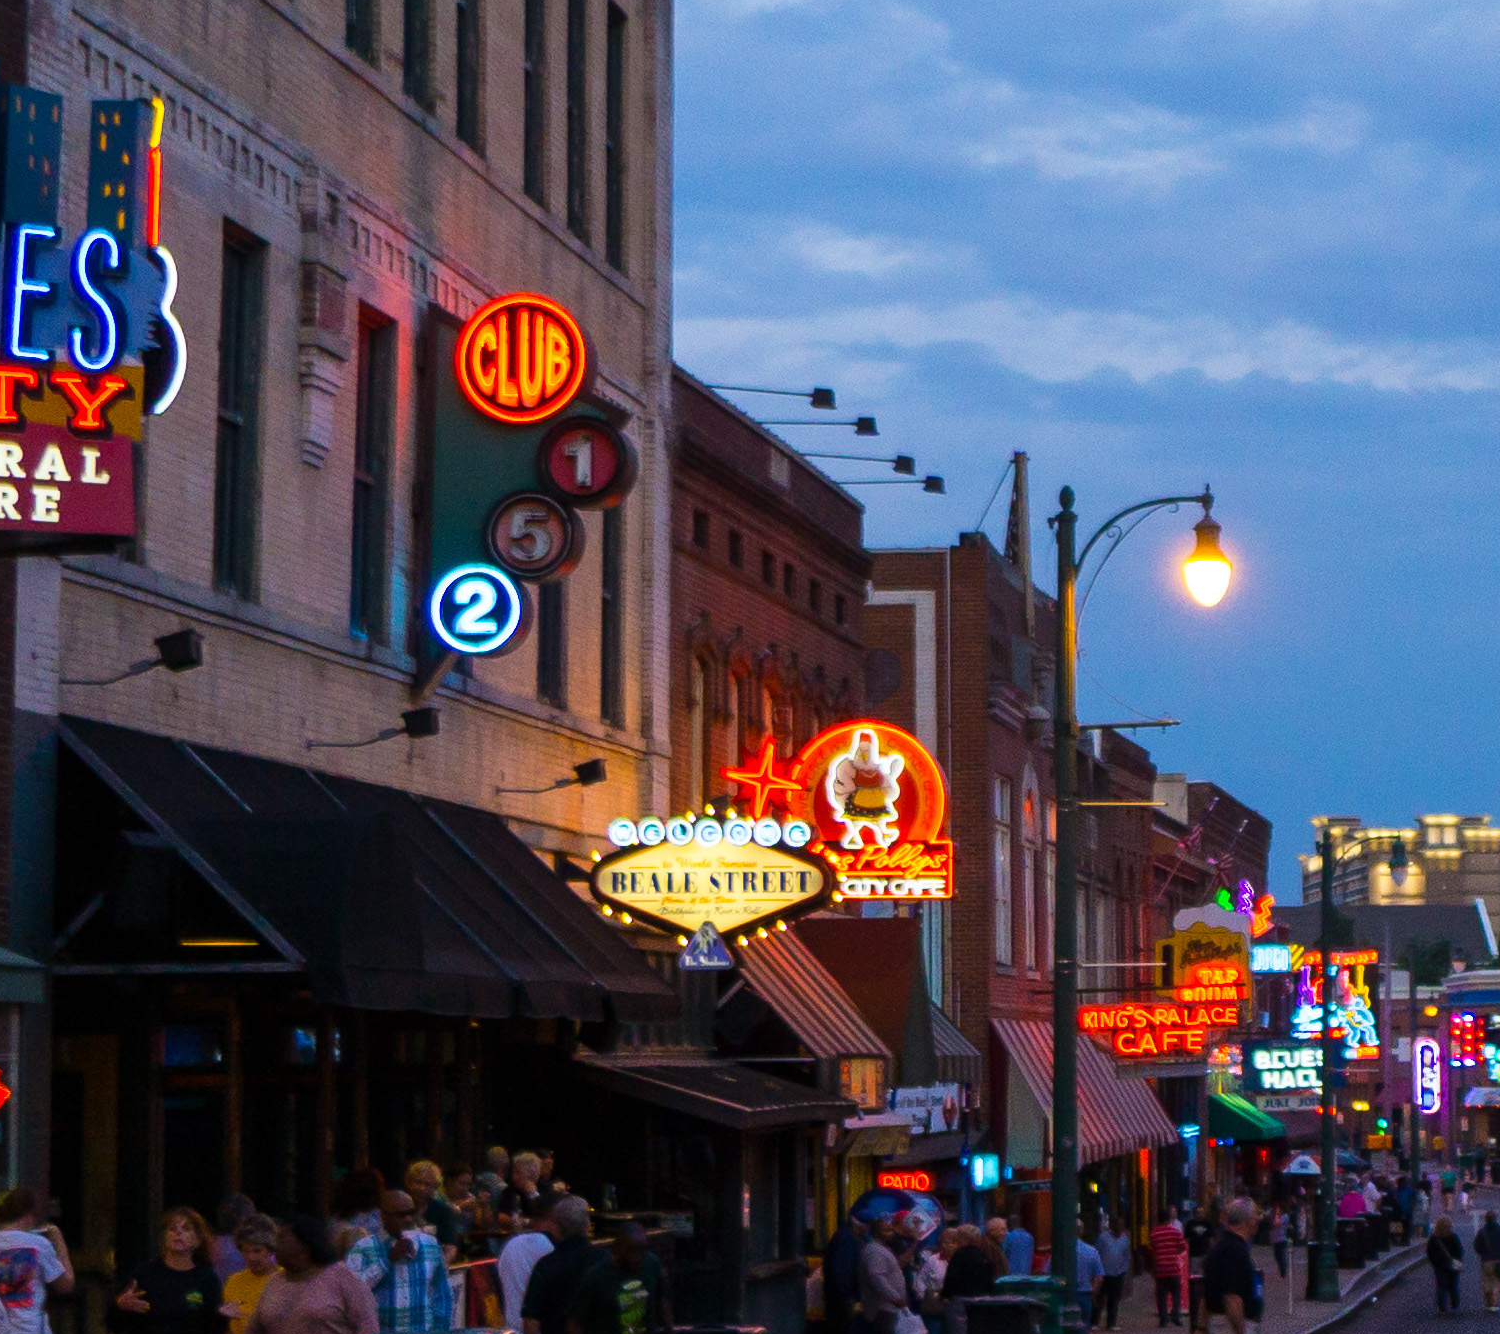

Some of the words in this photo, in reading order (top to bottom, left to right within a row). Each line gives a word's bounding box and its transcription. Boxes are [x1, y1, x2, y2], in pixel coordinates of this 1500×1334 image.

[471, 312, 571, 405] CLUB
[568, 433, 592, 488] 1
[509, 507, 553, 561] 5
[453, 581, 499, 637] 2
[676, 857, 711, 869] World
[717, 856, 758, 869] Famous
[611, 872, 698, 894] BEALE
[709, 871, 812, 894] STREET
[841, 878, 888, 895] CITY
[889, 878, 946, 895] CAFE
[1197, 969, 1238, 985] TAP
[1181, 986, 1237, 1001] ROOM
[1082, 1005, 1148, 1029] KING'S
[1152, 1005, 1238, 1027] PALACE
[1117, 1028, 1204, 1054] CAFE
[1262, 1070, 1322, 1089] HALL
[881, 1173, 930, 1191] PATIO
